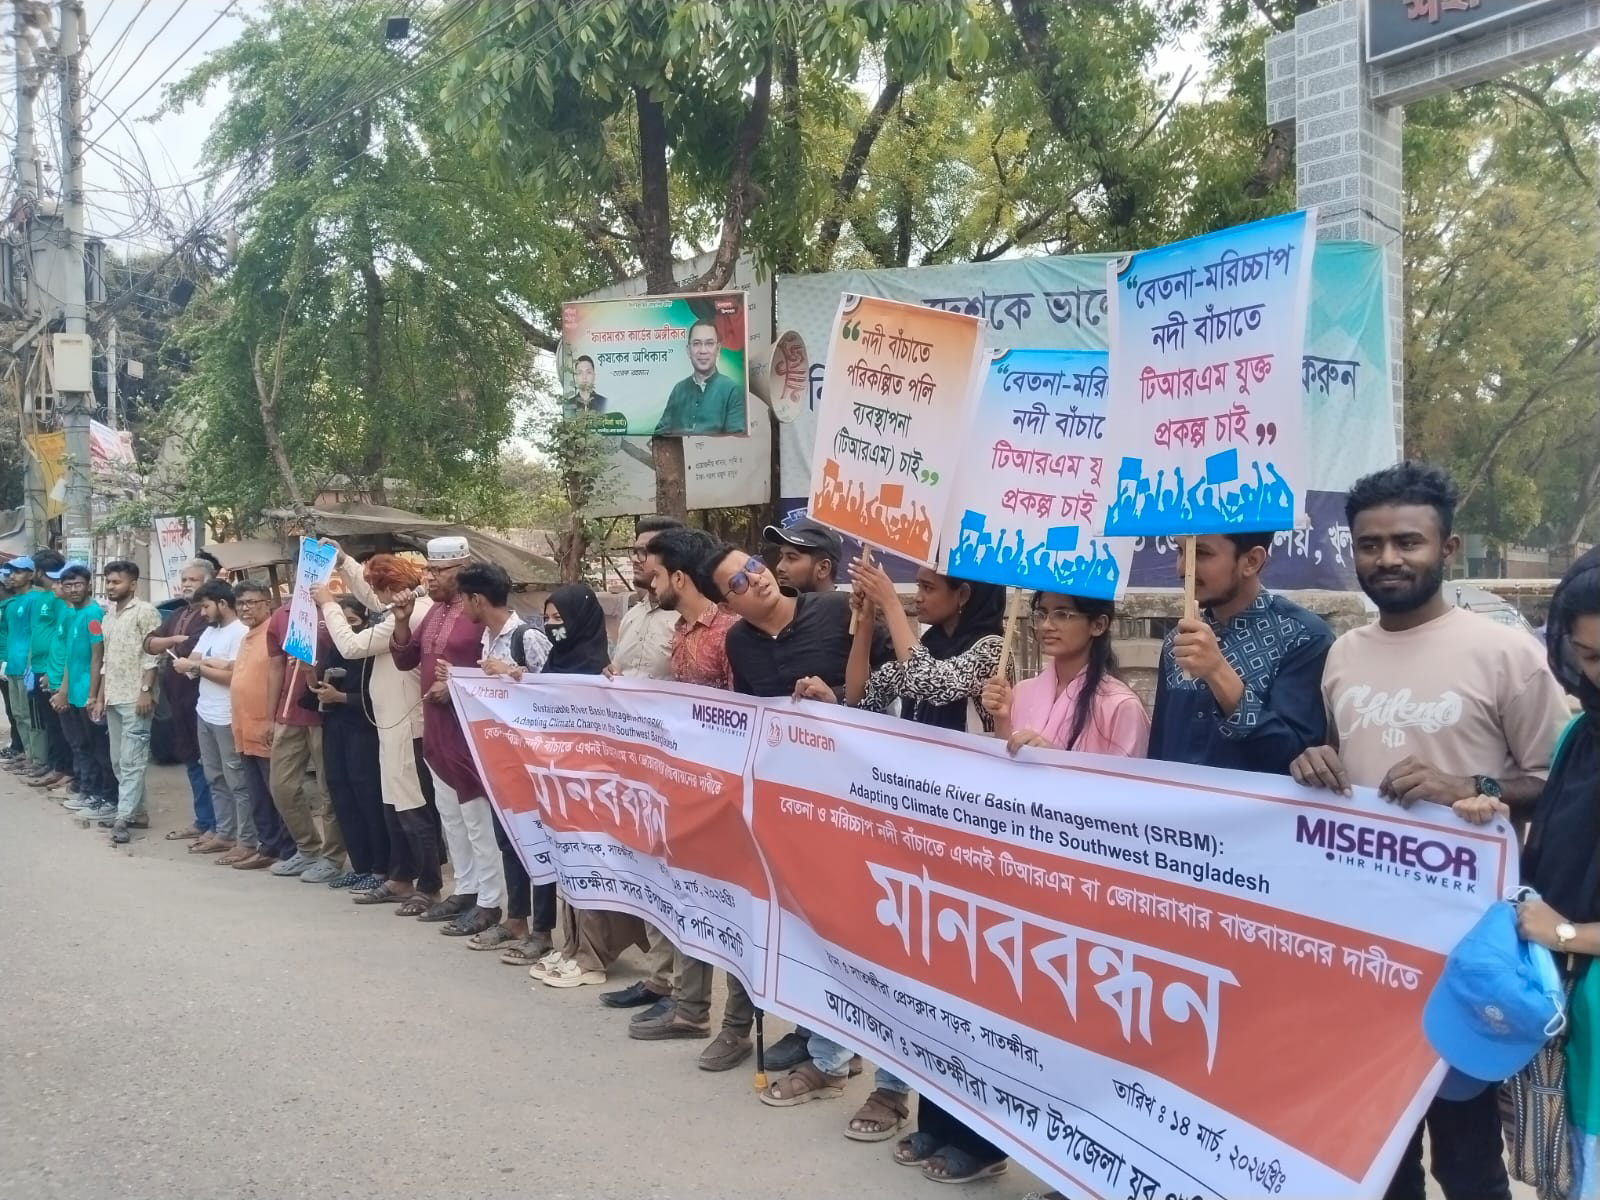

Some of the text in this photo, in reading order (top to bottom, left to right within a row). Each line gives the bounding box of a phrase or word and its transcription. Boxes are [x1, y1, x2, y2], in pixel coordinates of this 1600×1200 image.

[889, 328, 933, 363] বাঁচাতে
[1151, 303, 1266, 353] নদী বাঁচাতে
[847, 359, 905, 396] পরিকল্পিত
[908, 366, 936, 405] পলি
[1139, 353, 1274, 403] টিআরএম যুক্ত
[853, 401, 912, 438] ব্যবস্থাপনা
[1012, 401, 1050, 434] নদী
[1154, 416, 1209, 450] প্রকল্প
[833, 427, 895, 476] (টিআরএম)
[992, 440, 1085, 478] টিআরএম
[1001, 488, 1098, 525] প্রকল্প চাই
[571, 704, 588, 715] River
[692, 703, 749, 731] MISEREOR
[616, 724, 651, 740] Southwest
[787, 725, 836, 752] Uttaran
[872, 766, 1224, 857] Sustainable River Basin Management (SRBM):
[850, 782, 1270, 894] Adapting Climate Change in the Southwest Bangladesh
[1296, 814, 1477, 881] MISEREOR
[780, 796, 814, 821] বেতনা
[818, 807, 826, 822] ও
[876, 819, 898, 846] নদী
[900, 827, 946, 857] বাঁচাতে
[950, 845, 995, 876] এখনই
[999, 851, 1073, 893] টিআরএম
[1080, 876, 1101, 902] বা
[1342, 944, 1424, 991] দাবীতে
[1339, 854, 1476, 893] IHR HILFSWERK
[690, 918, 715, 943] পানি
[717, 924, 744, 958] কমিটি
[865, 859, 1241, 1076] মানববন্ধন
[893, 989, 937, 1021] প্রেসক্লাব
[980, 1026, 1044, 1072] সাতক্ষীরা,
[911, 1041, 989, 1106] সাতক্ষীরা
[994, 1089, 1040, 1133] সদর
[1046, 1103, 1126, 1189] উপজেলা
[1112, 1079, 1157, 1117] তারিখ
[1170, 1110, 1191, 1136] ১৪
[1197, 1123, 1227, 1162] মার্চ,
